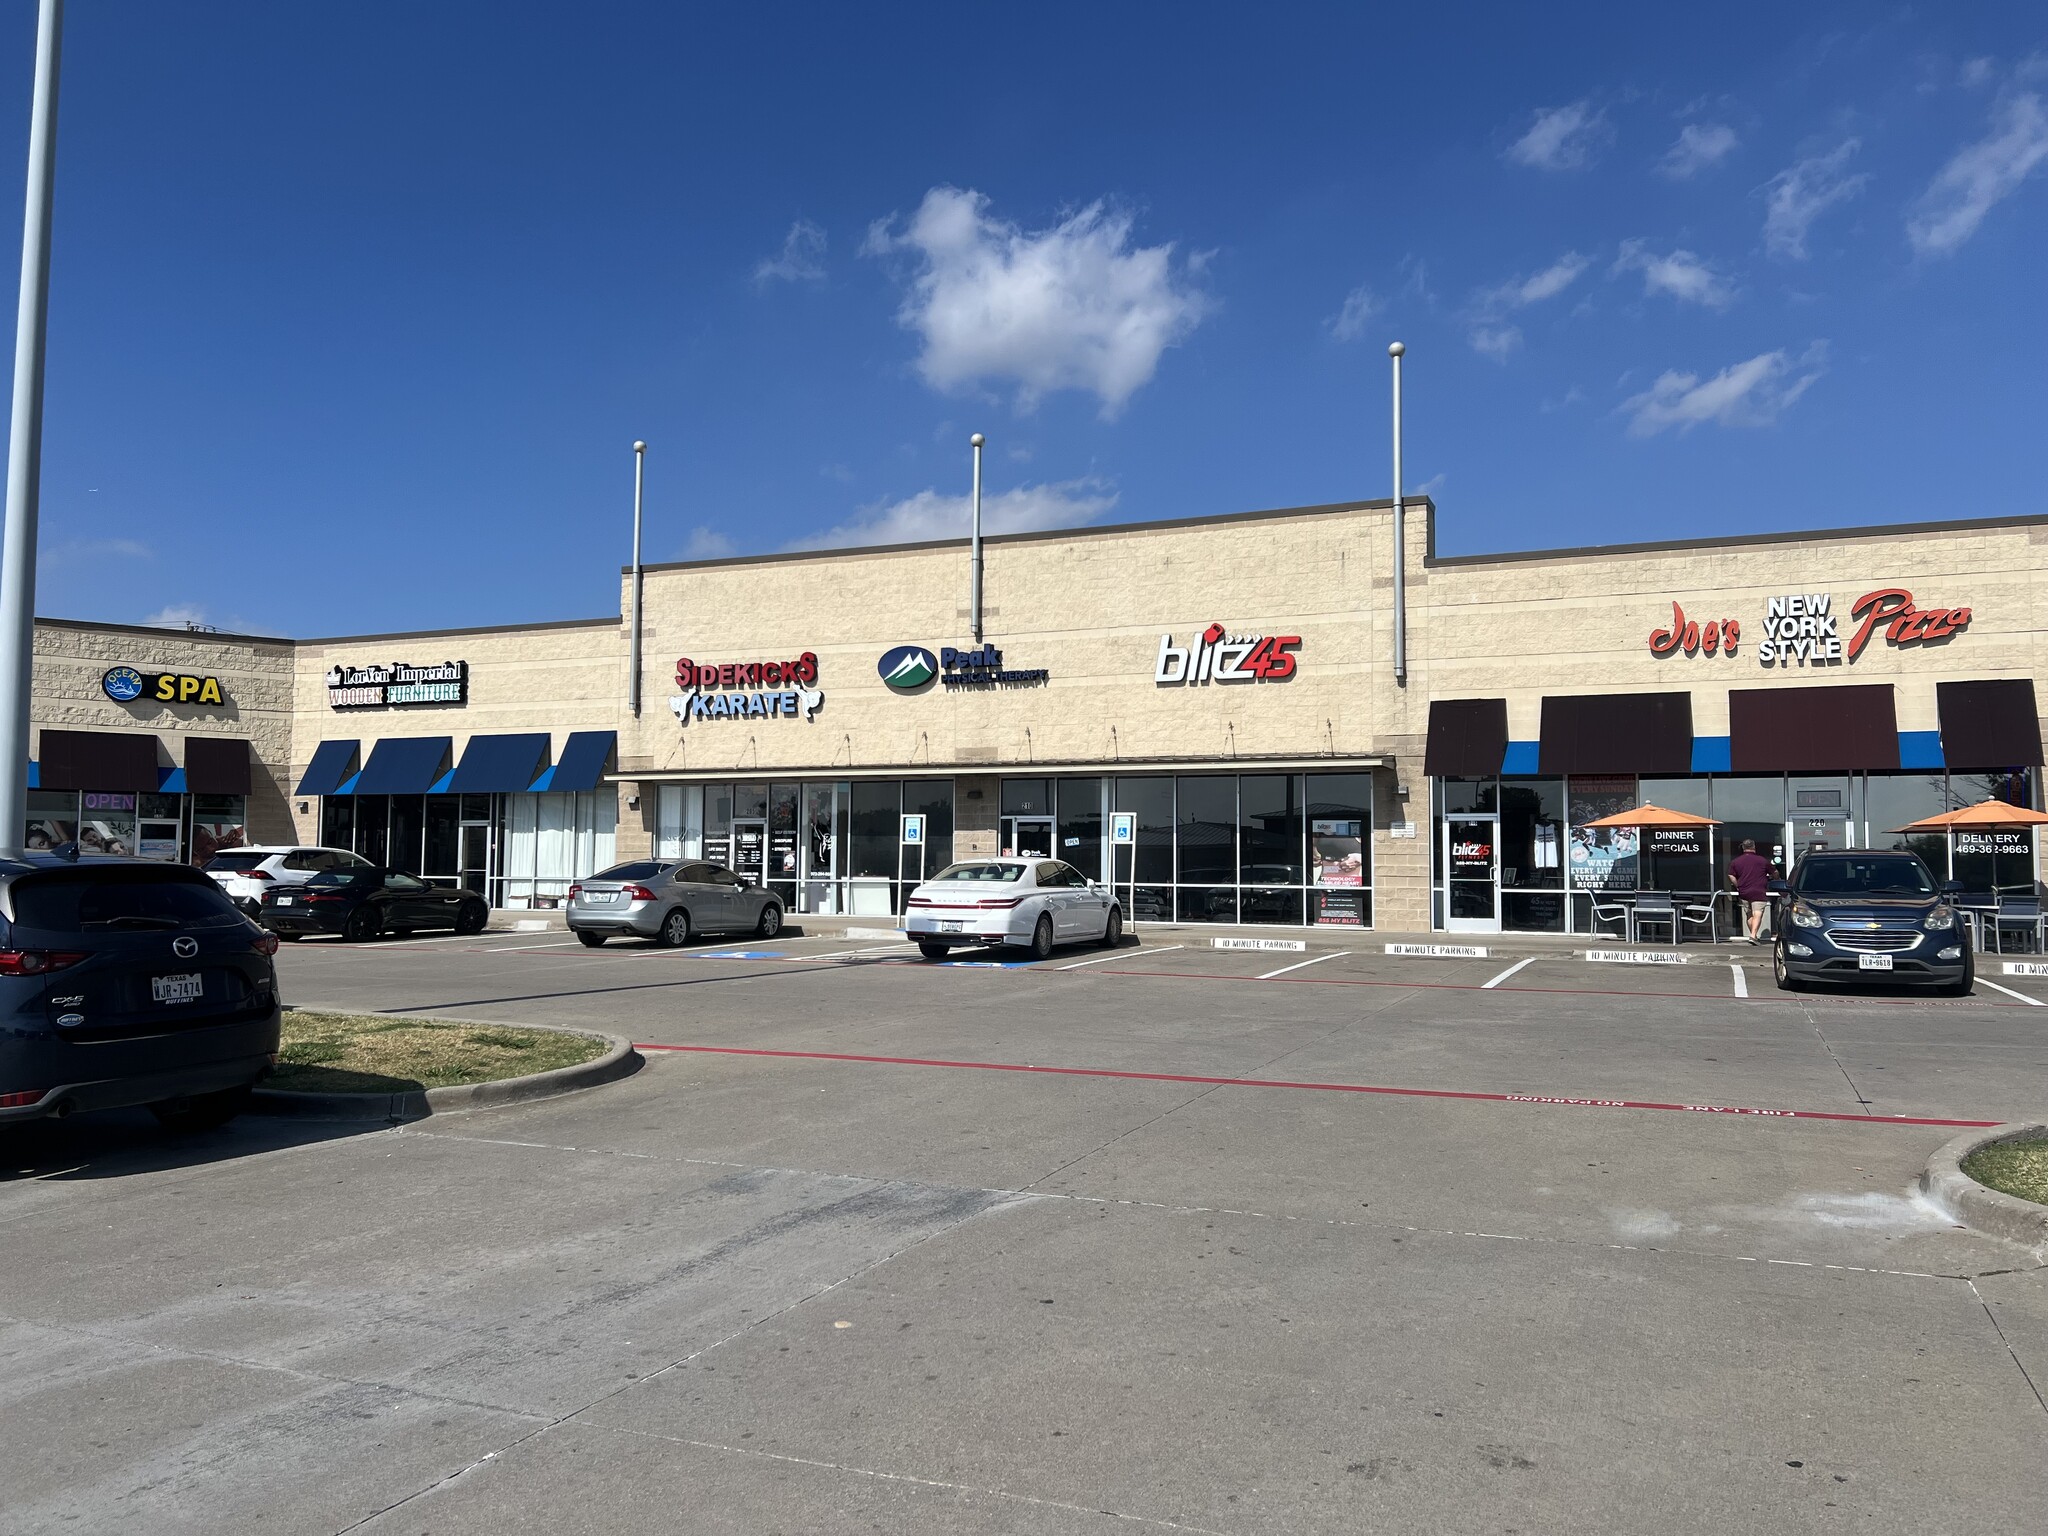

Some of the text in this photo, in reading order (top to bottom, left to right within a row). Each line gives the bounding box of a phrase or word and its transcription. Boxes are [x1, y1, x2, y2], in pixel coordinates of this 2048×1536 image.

[1768, 594, 1830, 617] NEW
[1650, 600, 1739, 652] Joe's
[1763, 616, 1836, 638] YORK
[1848, 588, 1972, 657] Pizza
[941, 644, 1001, 668] Peak
[1155, 623, 1301, 682] blitz45
[1759, 638, 1841, 660] STYLE
[108, 669, 141, 685] OCEAN
[396, 663, 461, 685] Imperial
[675, 652, 817, 686] SIDEKICKS
[941, 670, 1049, 684] PHYSICAL THERAPY
[156, 675, 221, 703] SPA
[329, 683, 460, 706] WOODEN FURNITURE
[692, 692, 796, 715] KARATE
[1571, 784, 1633, 793] EVERY SUNDAY
[85, 794, 134, 810] OPEN
[1809, 819, 1825, 827] 220
[1655, 831, 1694, 839] DINNER
[1452, 841, 1492, 855] blitz45
[1651, 844, 1700, 852] SPECIALS
[1956, 845, 2029, 854] 469-362-9663
[1232, 940, 1260, 948] MINUTE
[1264, 941, 1297, 949] PARKING
[1394, 945, 1476, 956] 10 MINUTE PARKING
[1591, 952, 1681, 963] 10 MINUTE PARKING
[2015, 964, 2024, 974] 10
[52, 995, 84, 1004] CX-5
[1506, 1095, 1591, 1105] PARKING
